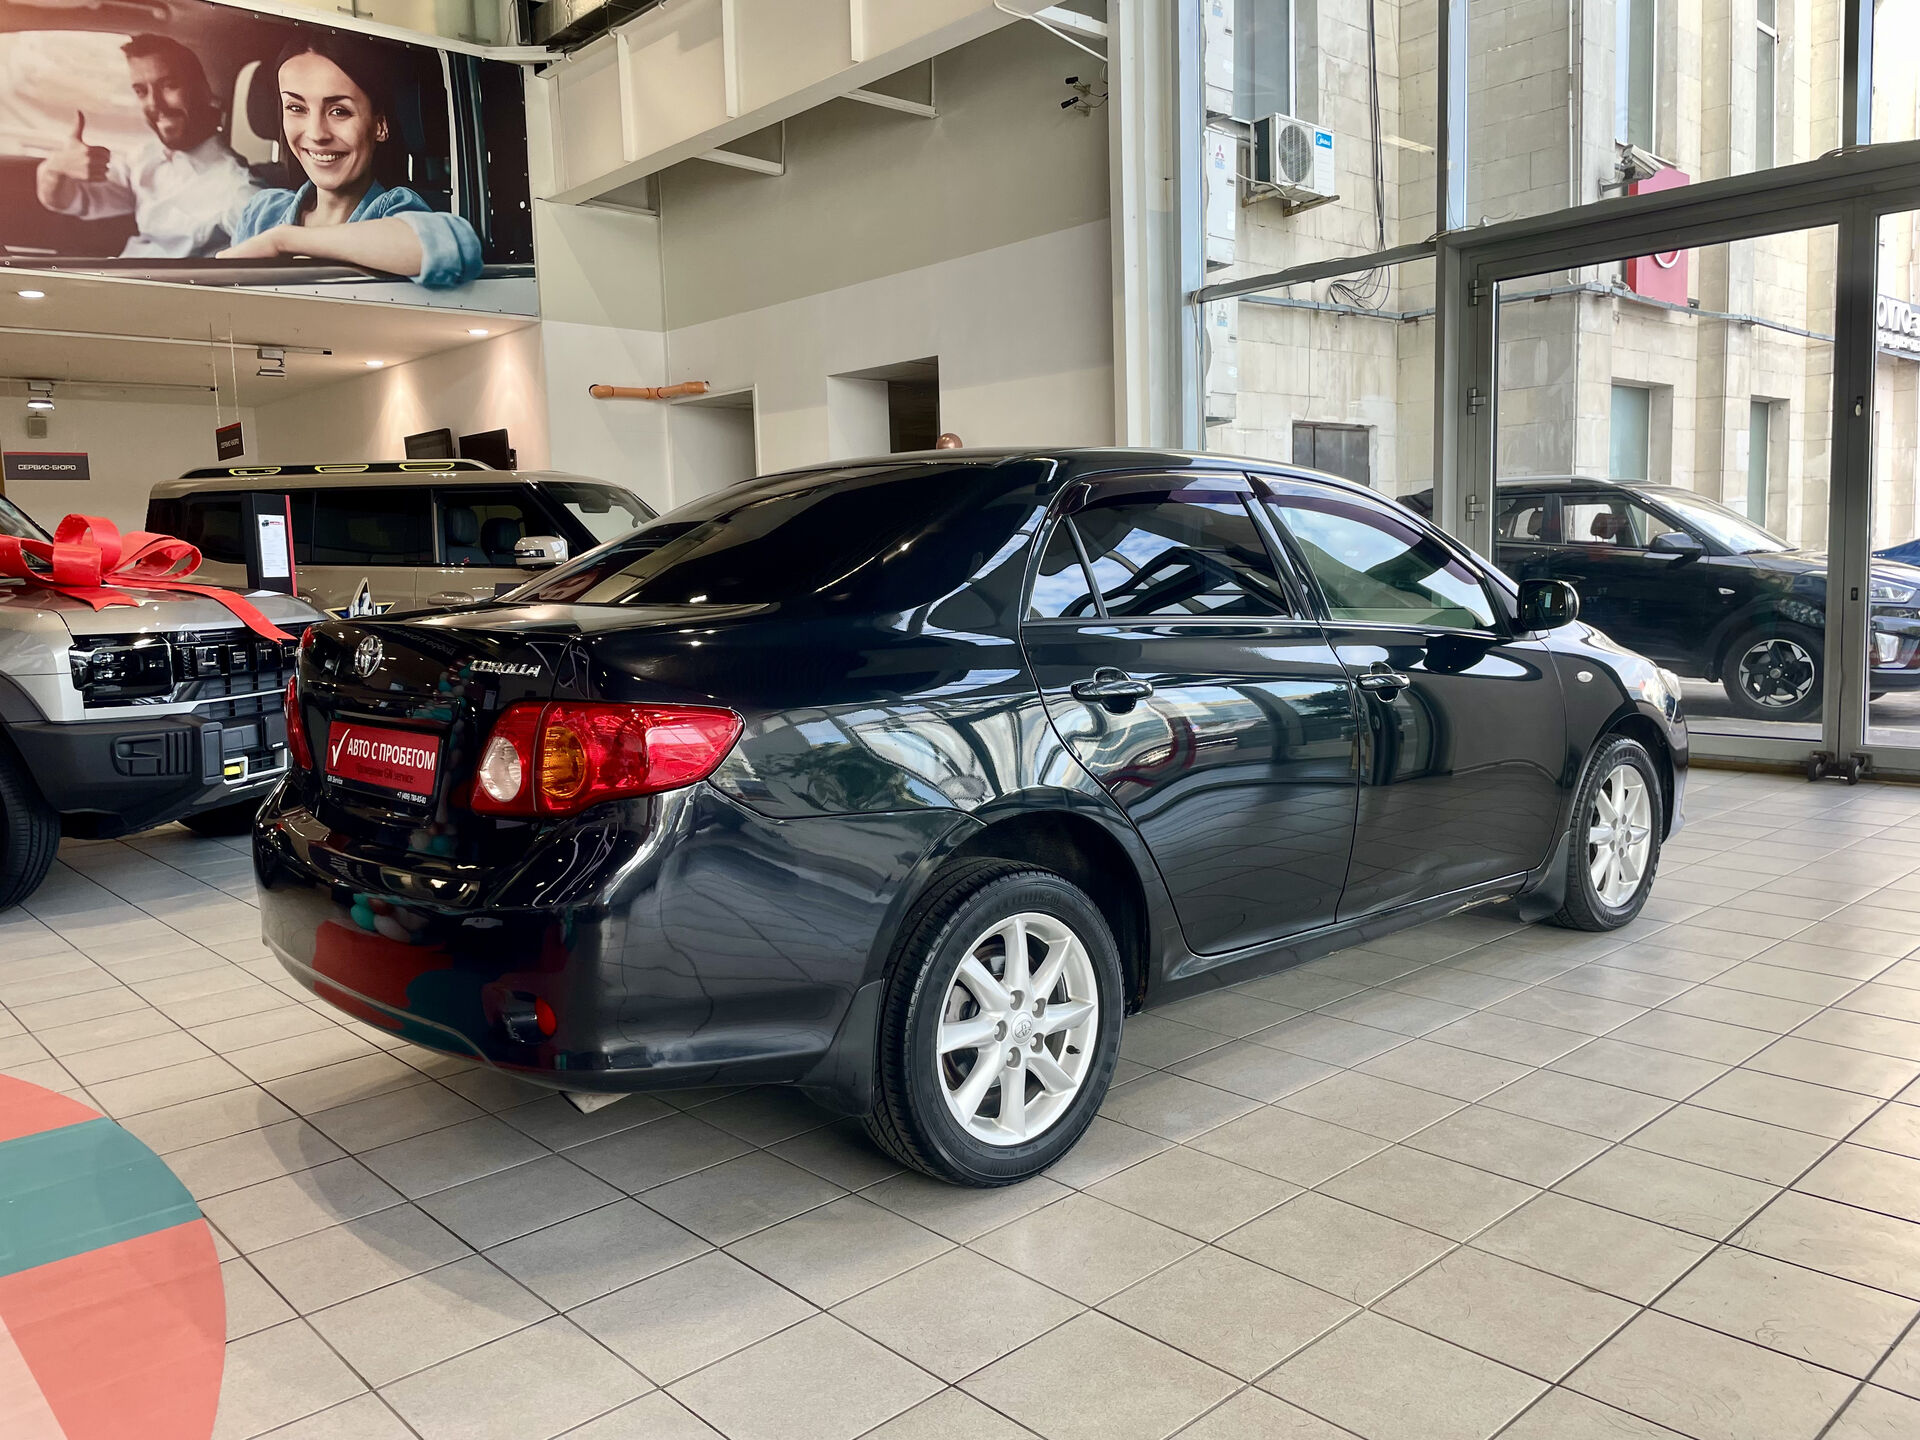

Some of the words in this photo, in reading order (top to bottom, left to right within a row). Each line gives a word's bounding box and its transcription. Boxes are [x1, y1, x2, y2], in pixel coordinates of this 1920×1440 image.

[201, 645, 297, 667] JETO
[469, 660, 542, 678] COROLLA
[346, 737, 370, 759] АВТО
[371, 742, 378, 760] С
[379, 743, 436, 771] ПРОБЕГОМ
